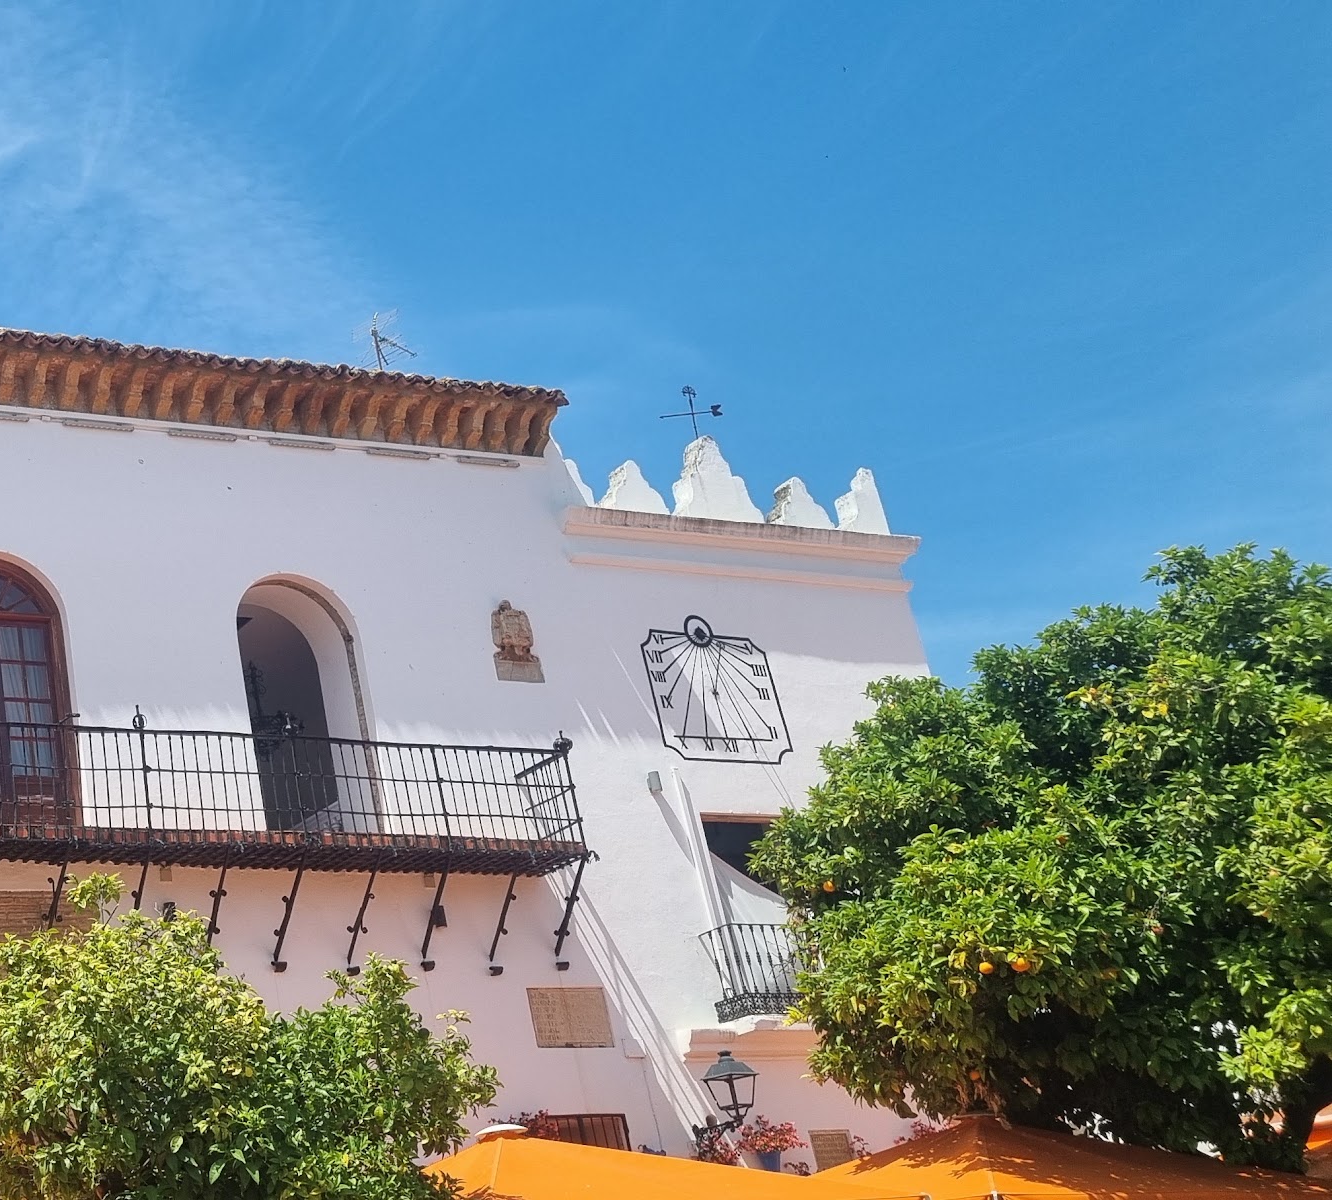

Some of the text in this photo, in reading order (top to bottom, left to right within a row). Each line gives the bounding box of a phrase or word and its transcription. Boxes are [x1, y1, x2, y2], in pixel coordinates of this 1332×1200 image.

[646, 650, 663, 663] VII
[757, 687, 770, 700] III
[660, 695, 674, 709] IX
[768, 726, 778, 739] II
[678, 736, 689, 749] X
[702, 737, 714, 751] XI
[722, 738, 740, 753] XII
